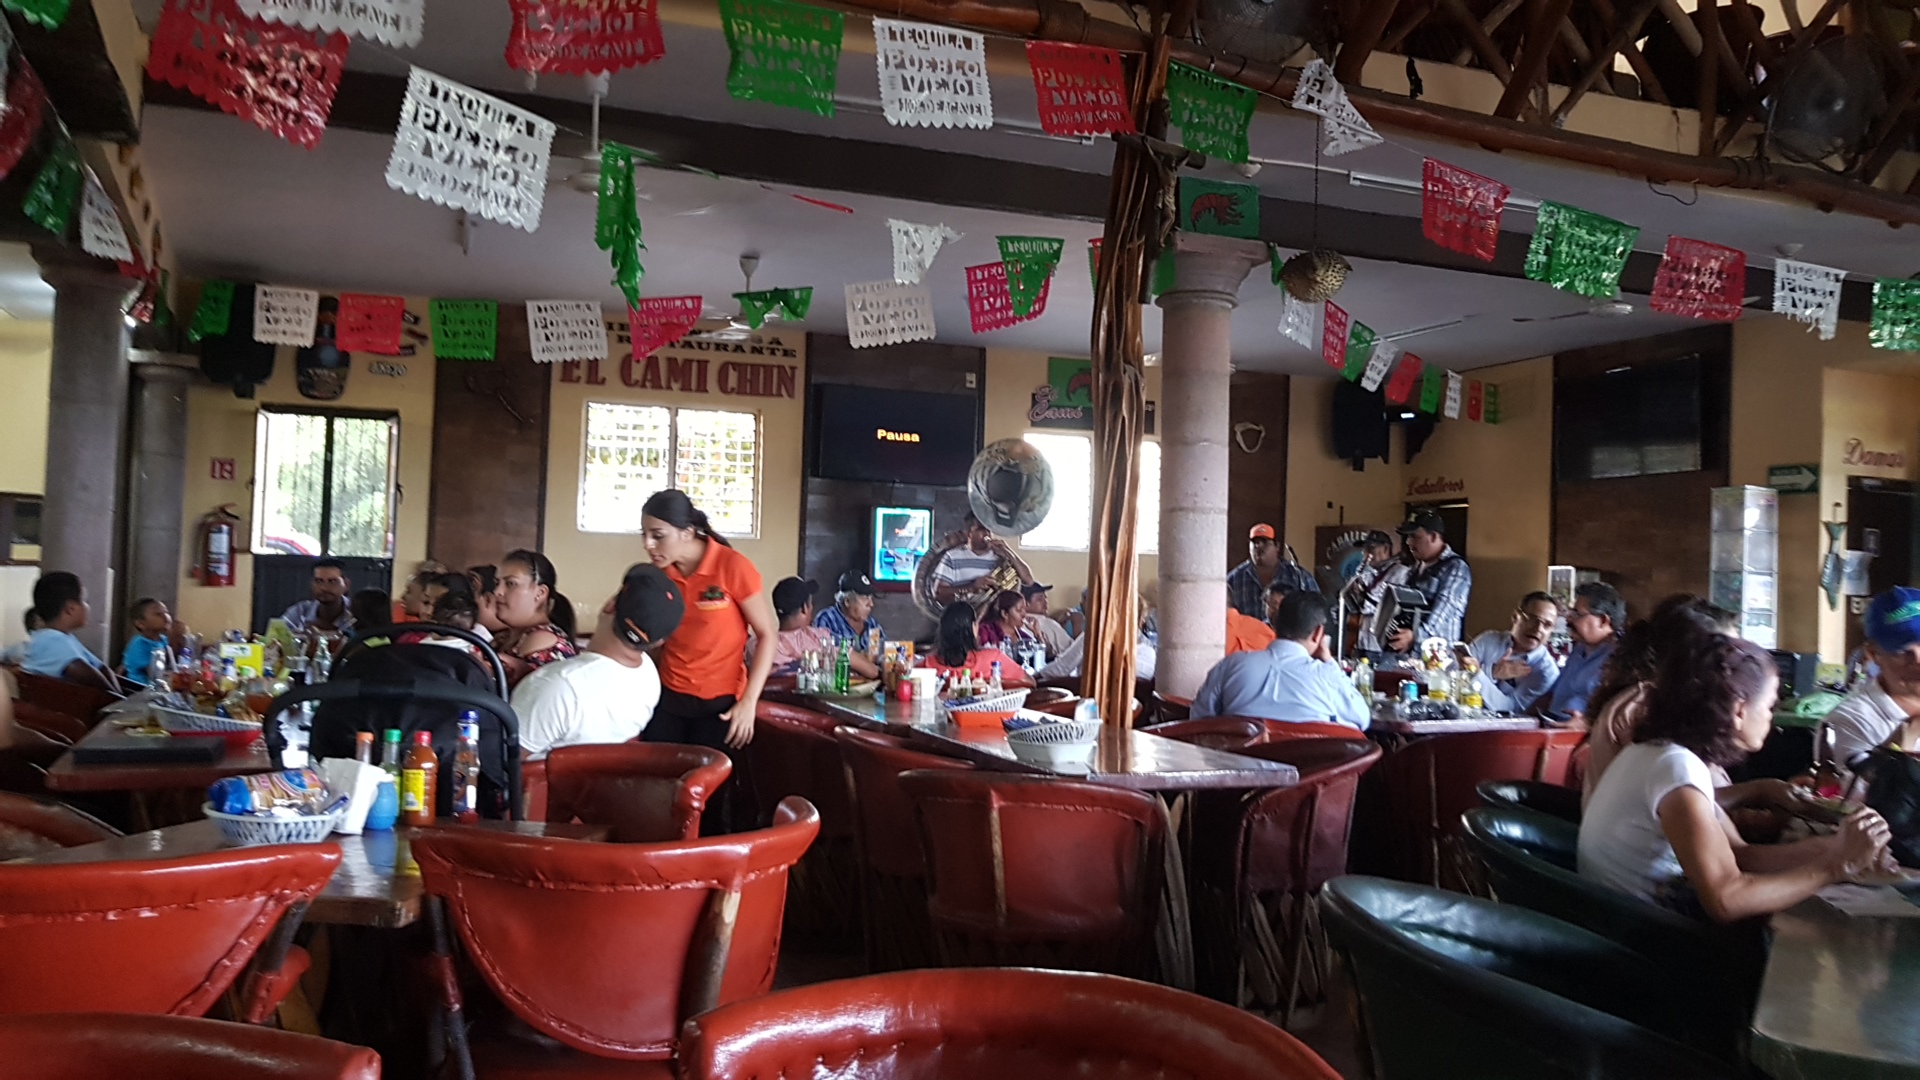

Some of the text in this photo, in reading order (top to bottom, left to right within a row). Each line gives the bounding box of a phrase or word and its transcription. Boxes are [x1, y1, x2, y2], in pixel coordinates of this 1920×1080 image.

[731, 18, 838, 61] PUEBLO
[887, 26, 974, 51] TEQUILA
[884, 49, 982, 78] PUEBLO
[900, 73, 975, 96] VIEJO
[1036, 67, 1119, 91] PUEBLO
[427, 79, 536, 139] TEQUILA
[943, 100, 984, 116] AGAVE
[412, 101, 538, 171] PUEBLO
[421, 135, 521, 188] VIEJO
[1006, 240, 1061, 258] TEQUILA
[616, 333, 797, 359] RTAURANTE
[560, 353, 798, 399] EL CAMI CHIN
[877, 428, 921, 443] Pausa
